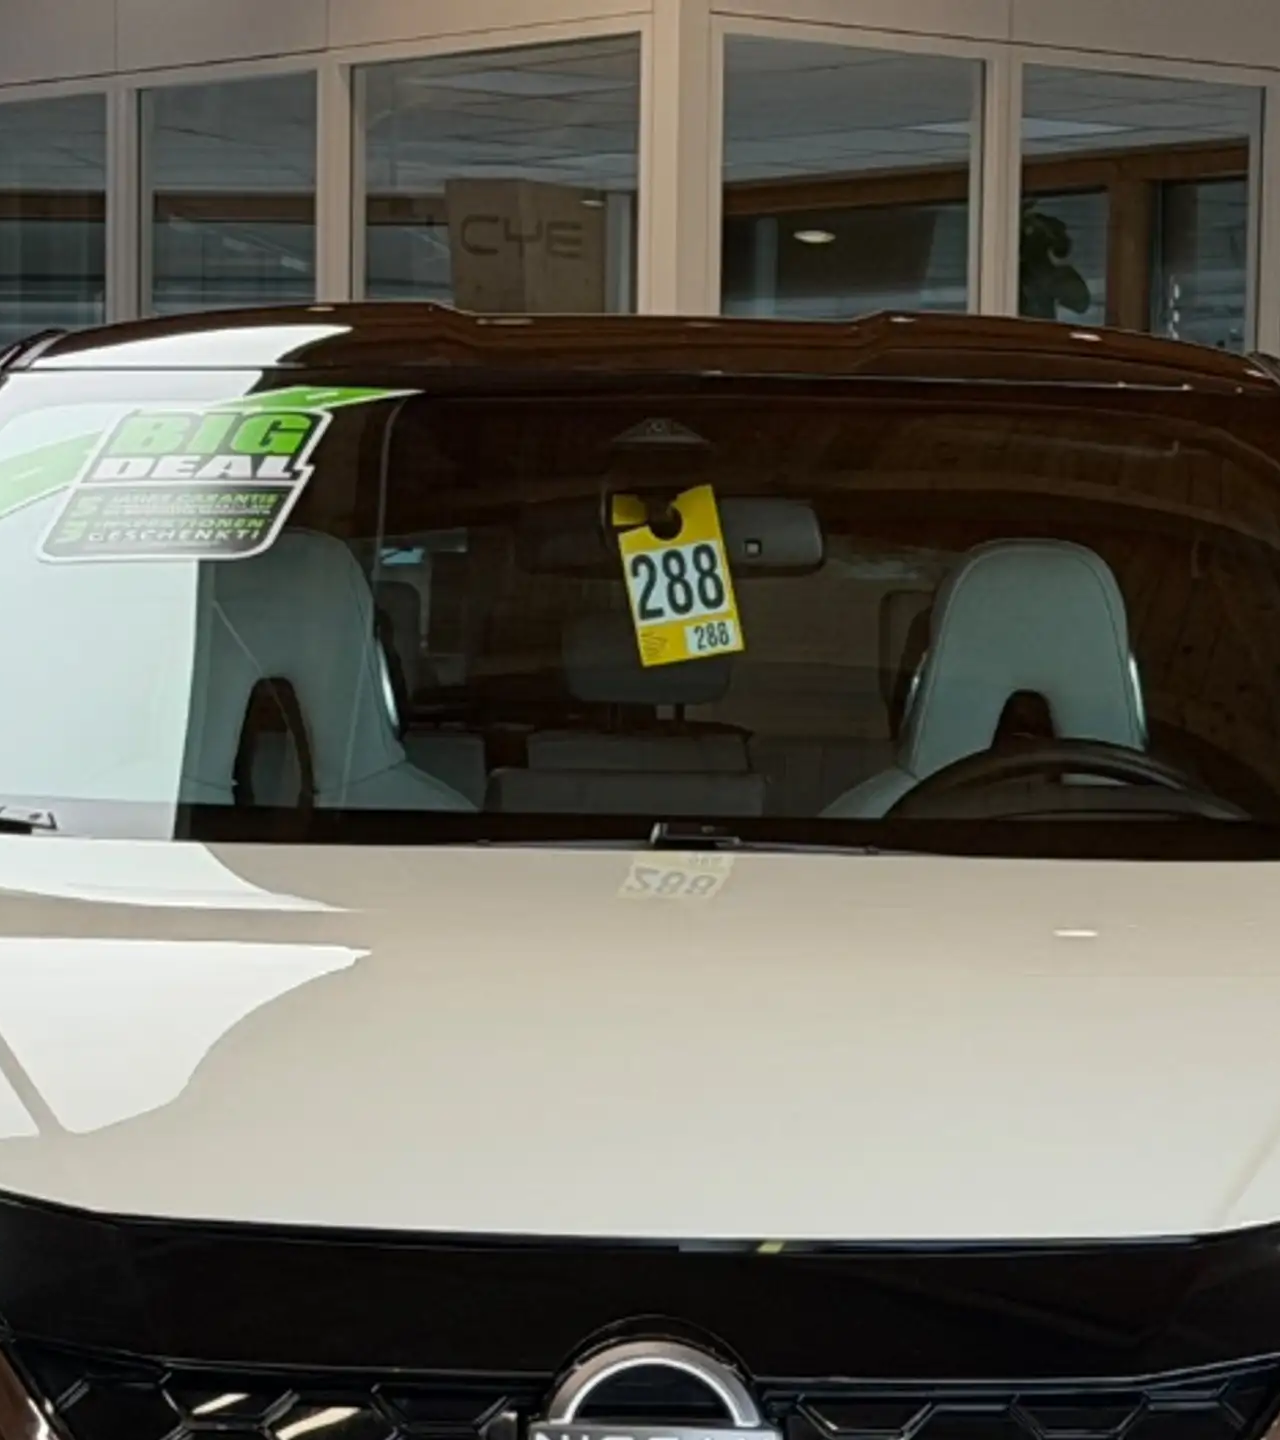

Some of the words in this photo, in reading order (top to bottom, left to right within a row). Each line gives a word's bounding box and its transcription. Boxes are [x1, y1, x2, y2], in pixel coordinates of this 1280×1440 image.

[107, 412, 313, 456] BIG
[89, 455, 298, 481] DEAL
[630, 543, 725, 620] 288
[693, 622, 730, 651] 288
